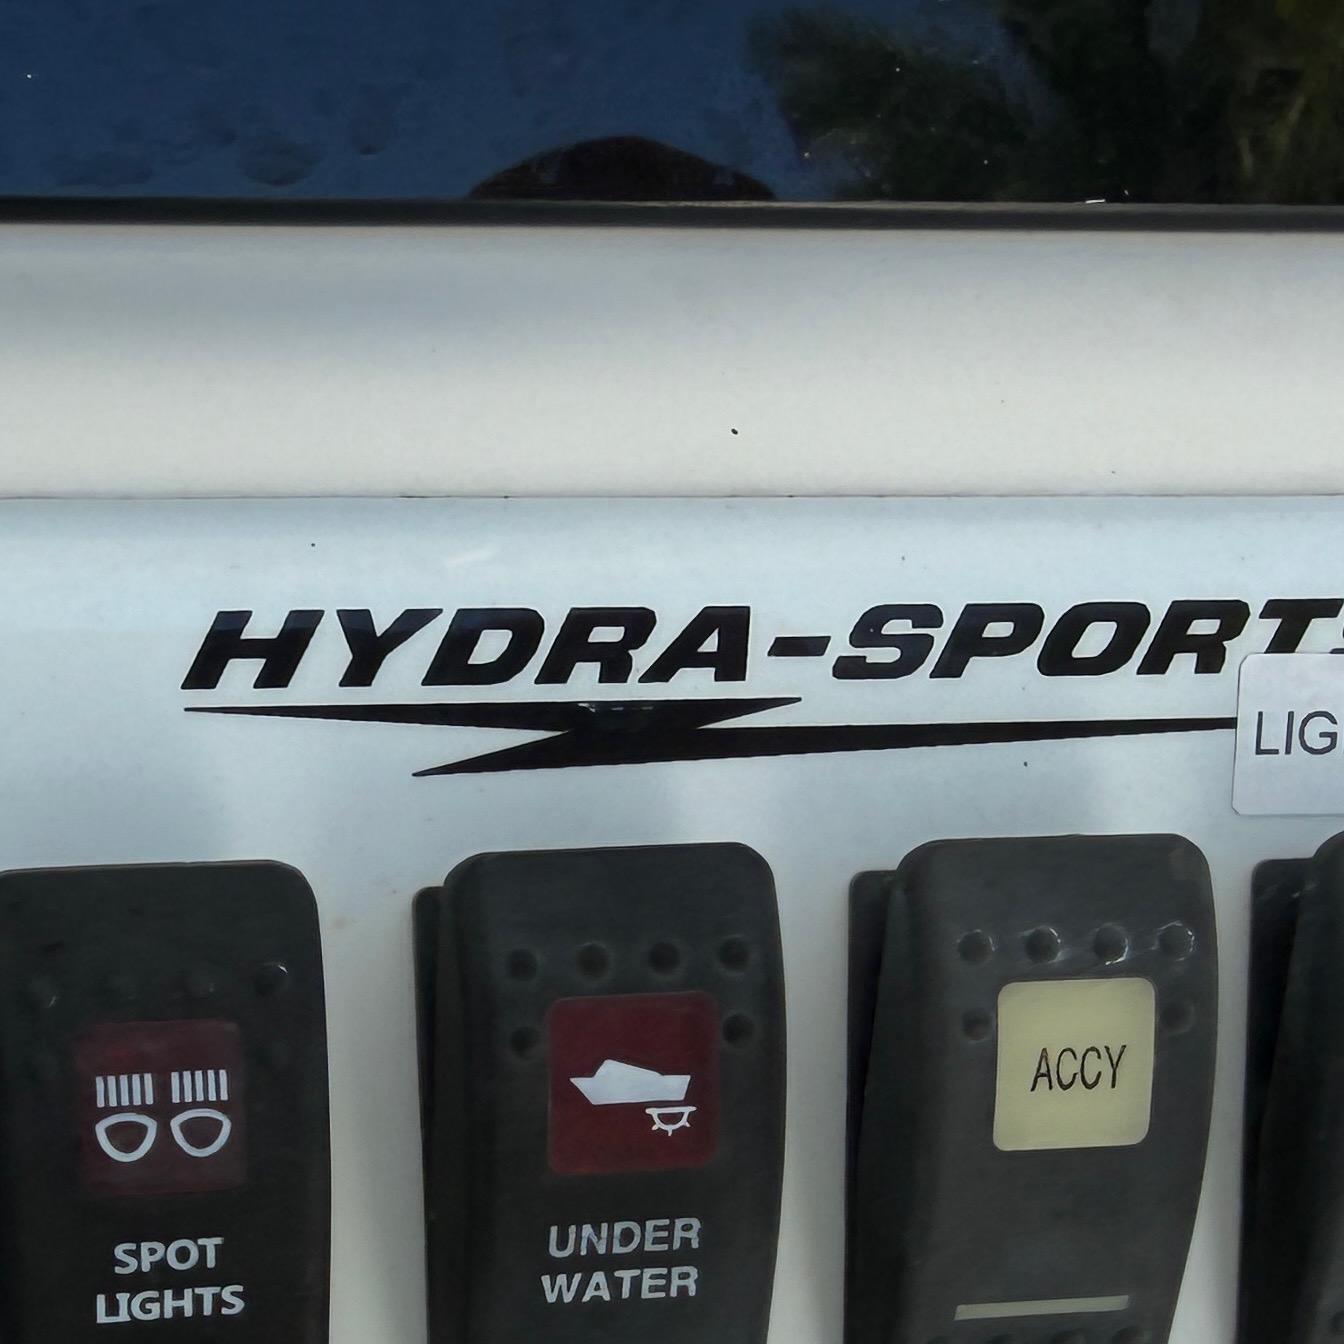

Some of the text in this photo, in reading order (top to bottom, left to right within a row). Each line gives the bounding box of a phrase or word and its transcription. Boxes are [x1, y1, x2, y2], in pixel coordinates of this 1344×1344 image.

[1029, 1044, 1128, 1093] ACCY
[113, 1236, 225, 1275] SPOT
[548, 1216, 702, 1258] UNDER
[95, 1284, 246, 1324] LIGHTS
[540, 1265, 699, 1304] WATER
